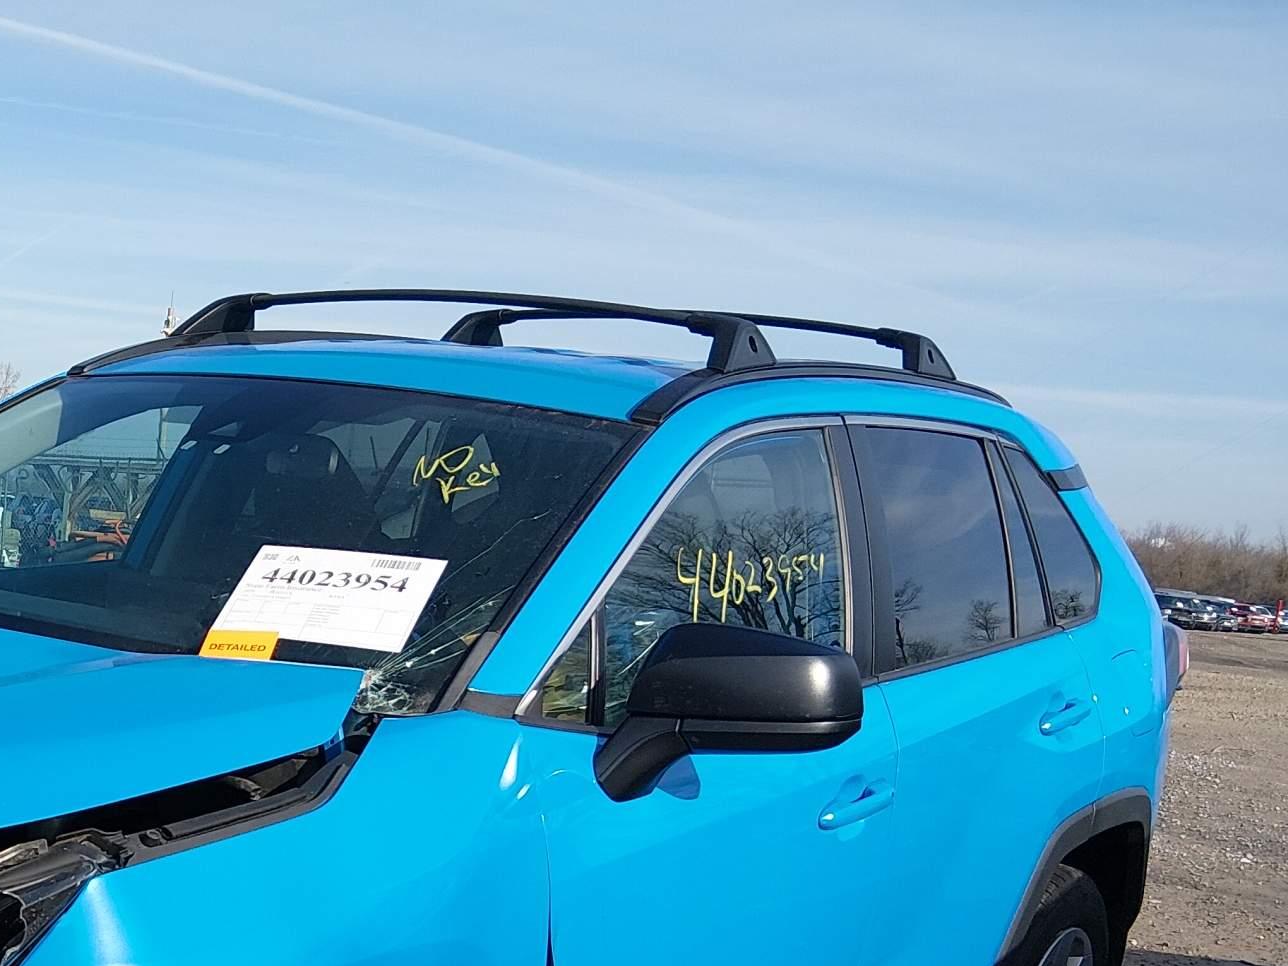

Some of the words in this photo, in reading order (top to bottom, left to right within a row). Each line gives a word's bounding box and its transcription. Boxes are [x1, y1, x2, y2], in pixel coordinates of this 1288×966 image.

[262, 567, 409, 593] 44023954
[677, 547, 825, 623] 44023954
[208, 643, 267, 652] DETAILED
